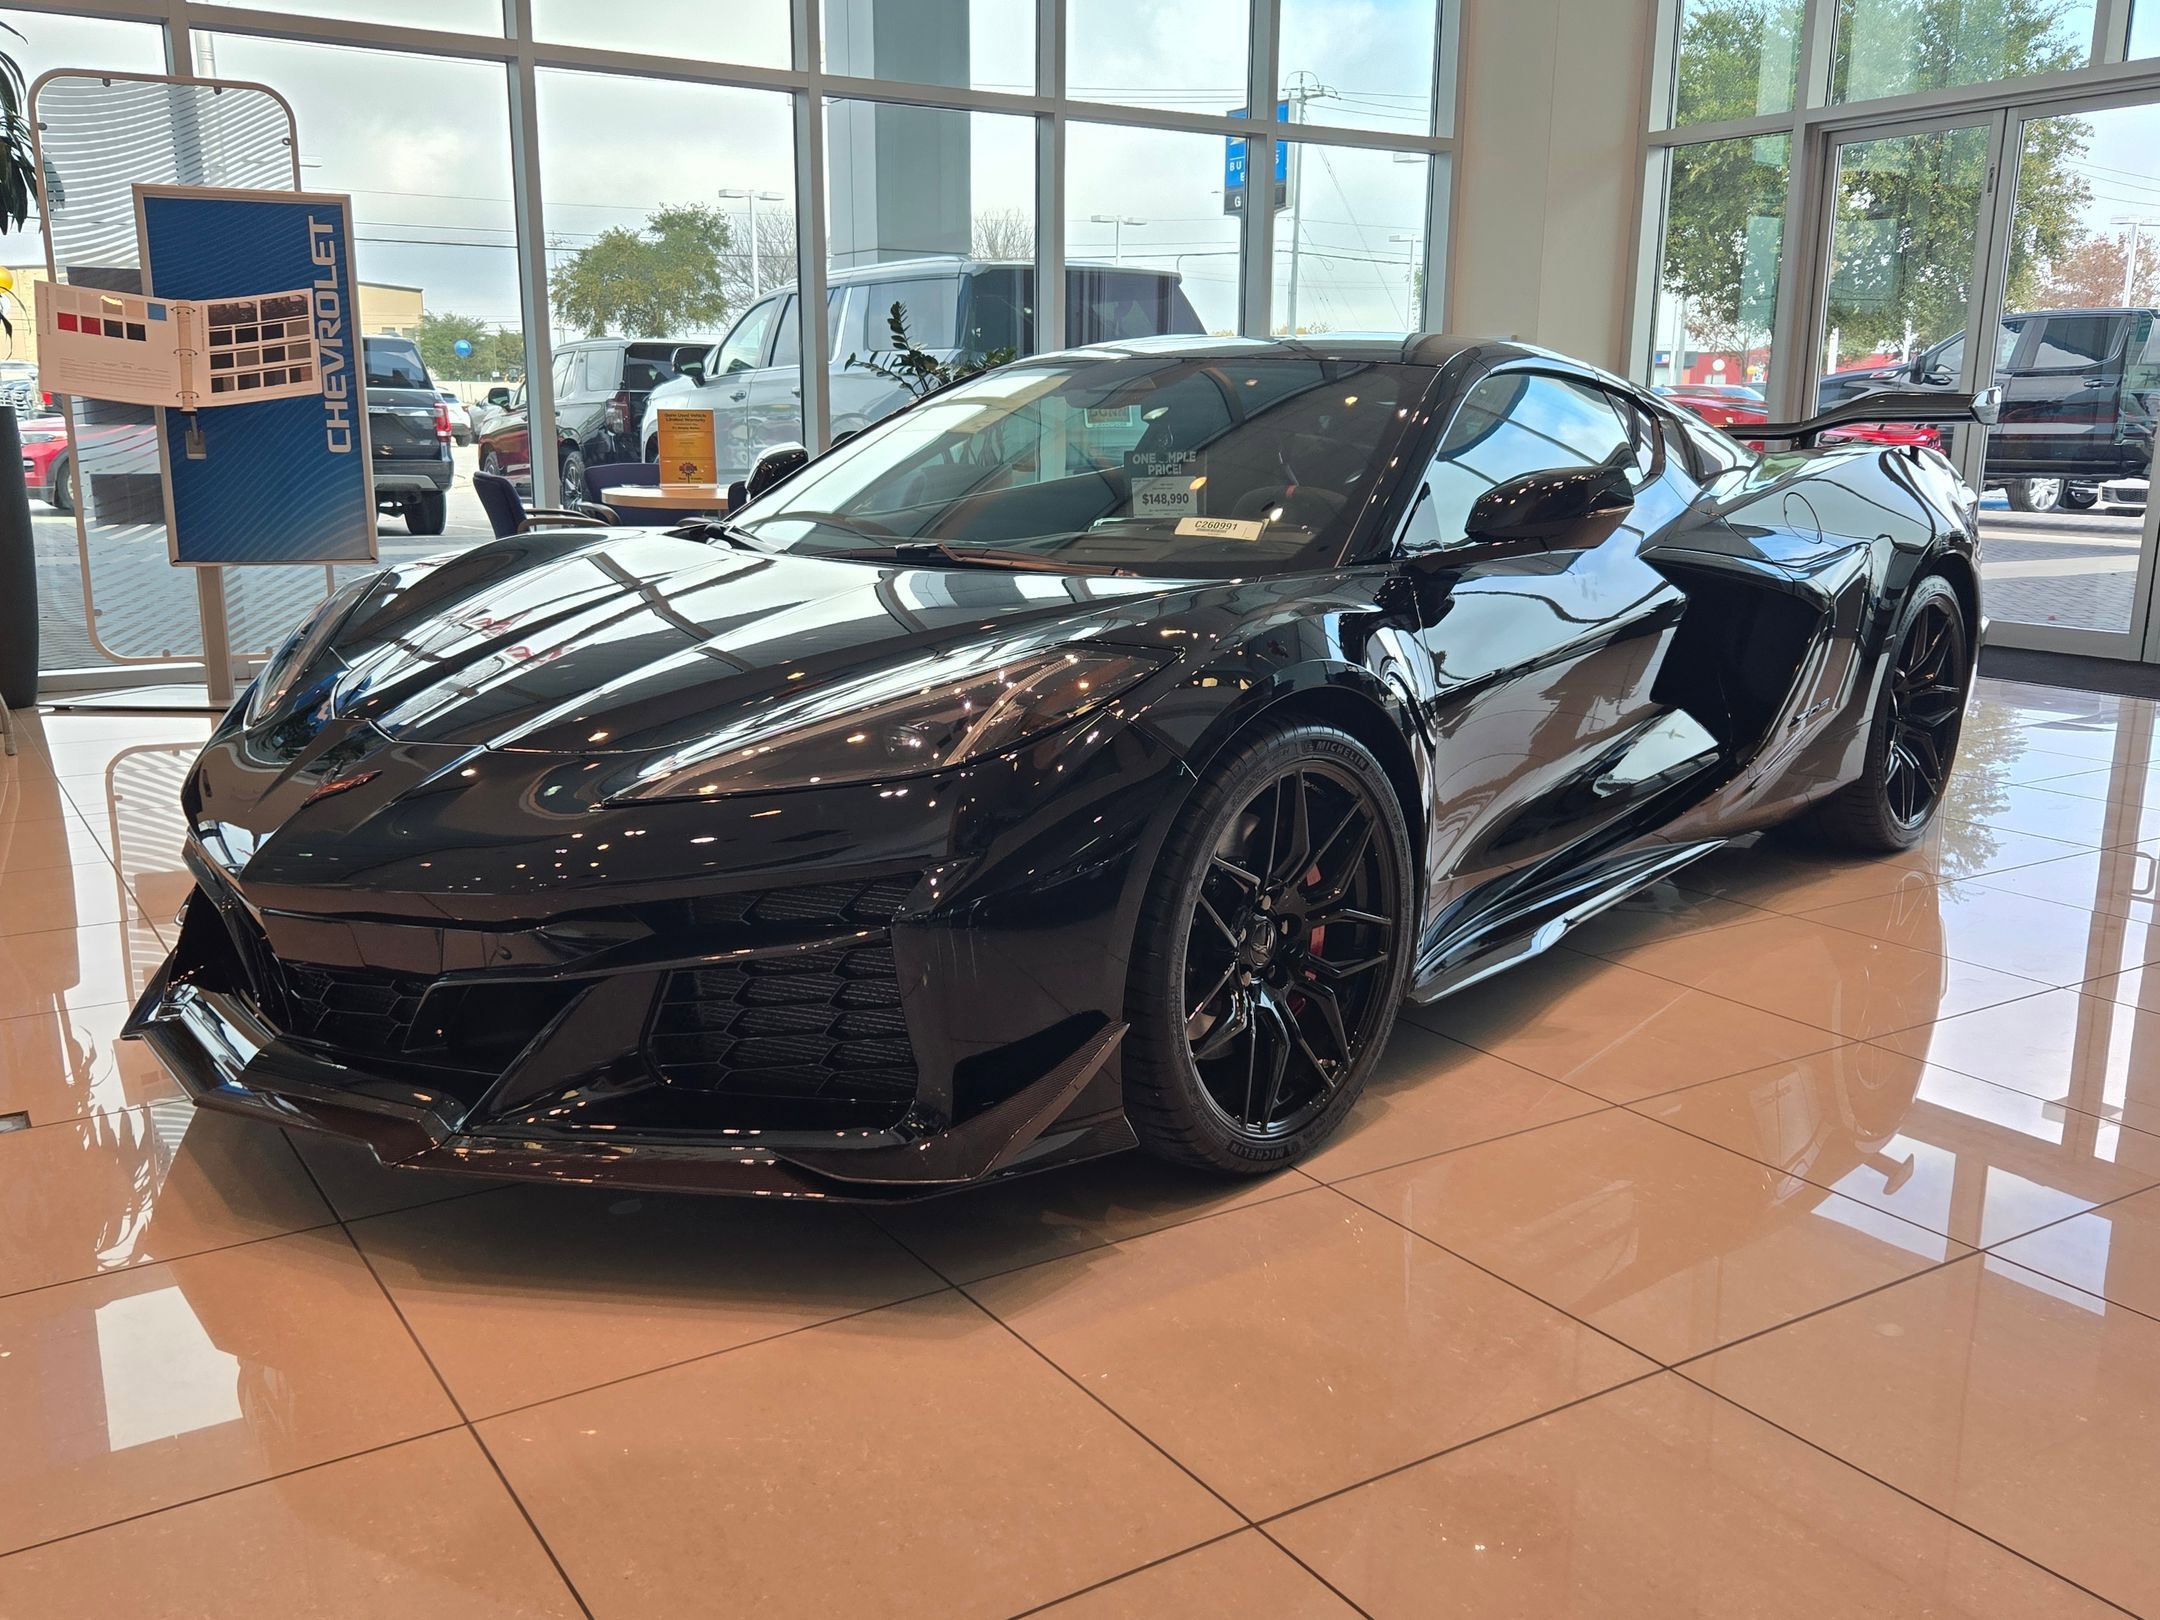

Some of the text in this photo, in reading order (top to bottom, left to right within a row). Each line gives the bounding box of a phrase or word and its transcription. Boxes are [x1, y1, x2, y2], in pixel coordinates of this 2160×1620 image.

[308, 214, 351, 454] CHEVROLET
[1132, 451, 1197, 465] ONE MPLE
[1147, 463, 1182, 476] PRICE!
[1142, 492, 1190, 506] $148,990
[1194, 519, 1239, 531] C260991
[1315, 740, 1370, 770] MICHELIN
[1229, 1142, 1286, 1160] MICHELIN
